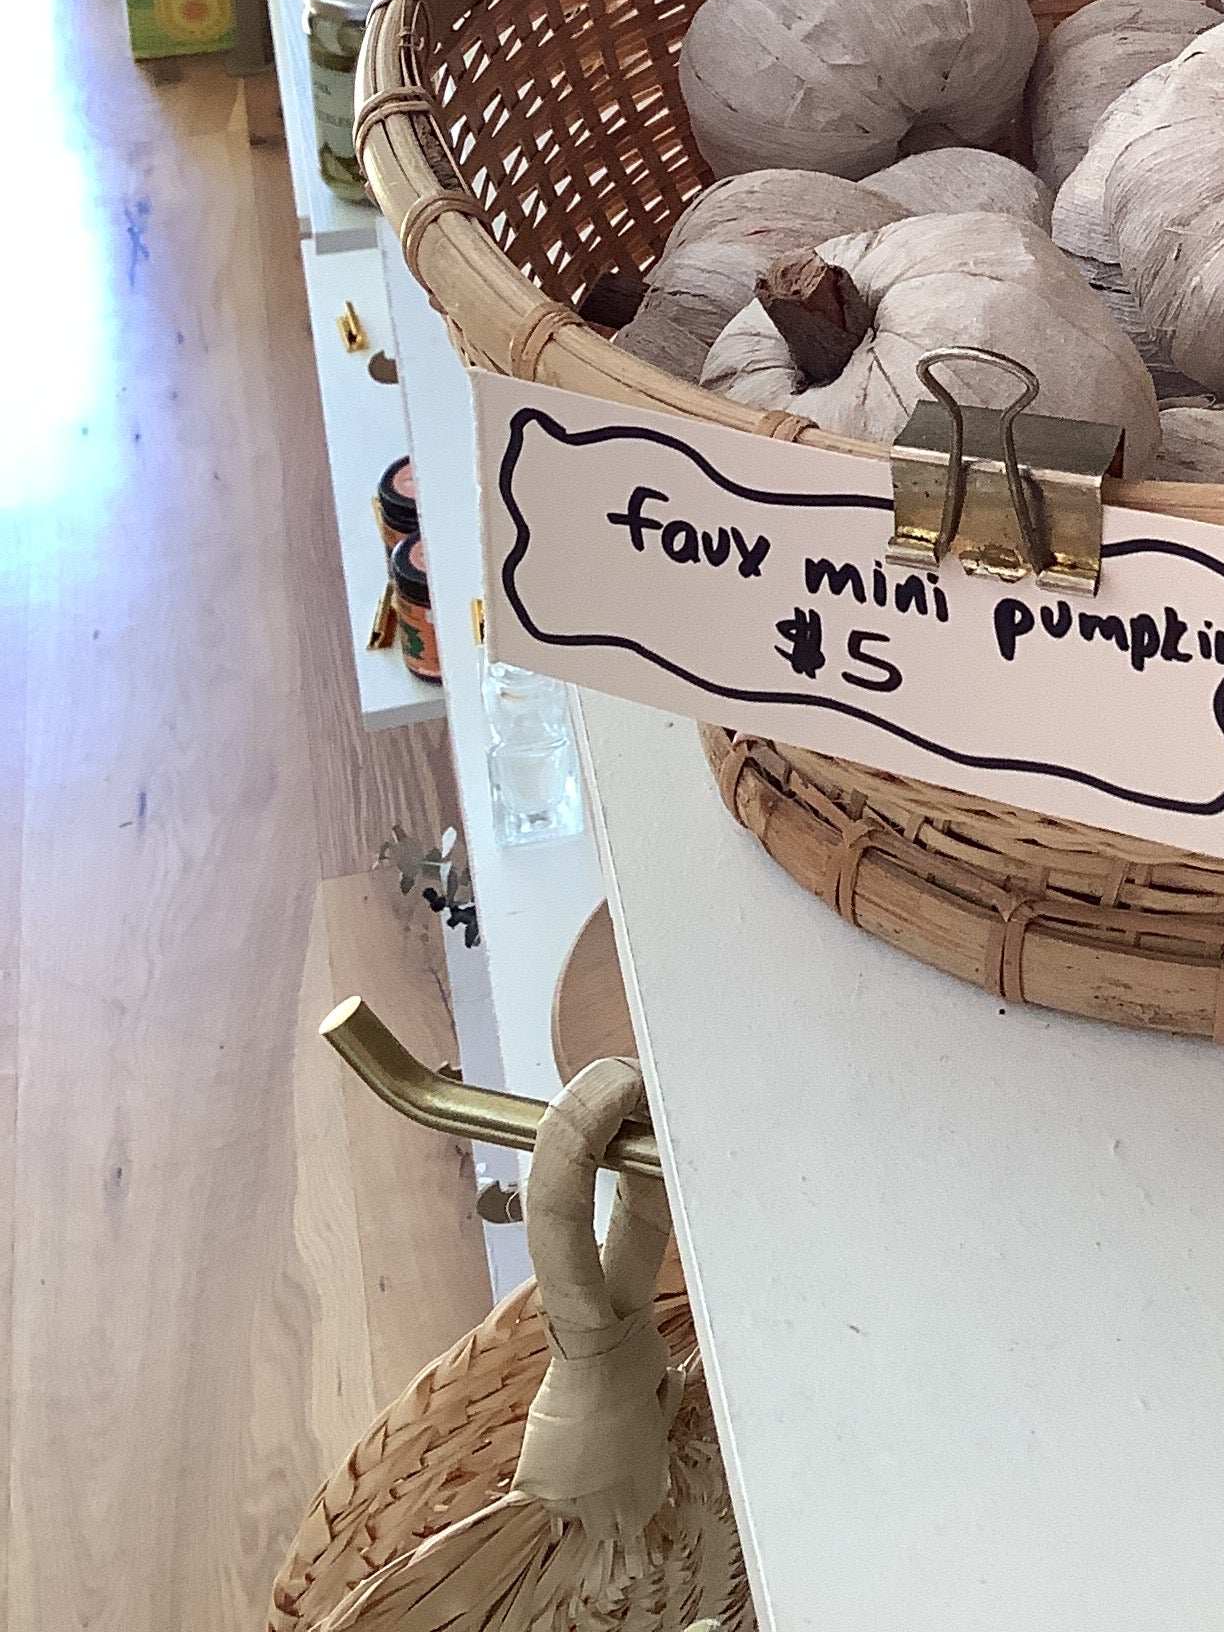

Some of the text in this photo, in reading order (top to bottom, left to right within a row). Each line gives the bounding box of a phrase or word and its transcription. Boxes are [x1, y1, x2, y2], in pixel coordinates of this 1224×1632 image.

[607, 486, 771, 578] faux
[804, 558, 949, 622] mini
[774, 607, 903, 692] $5
